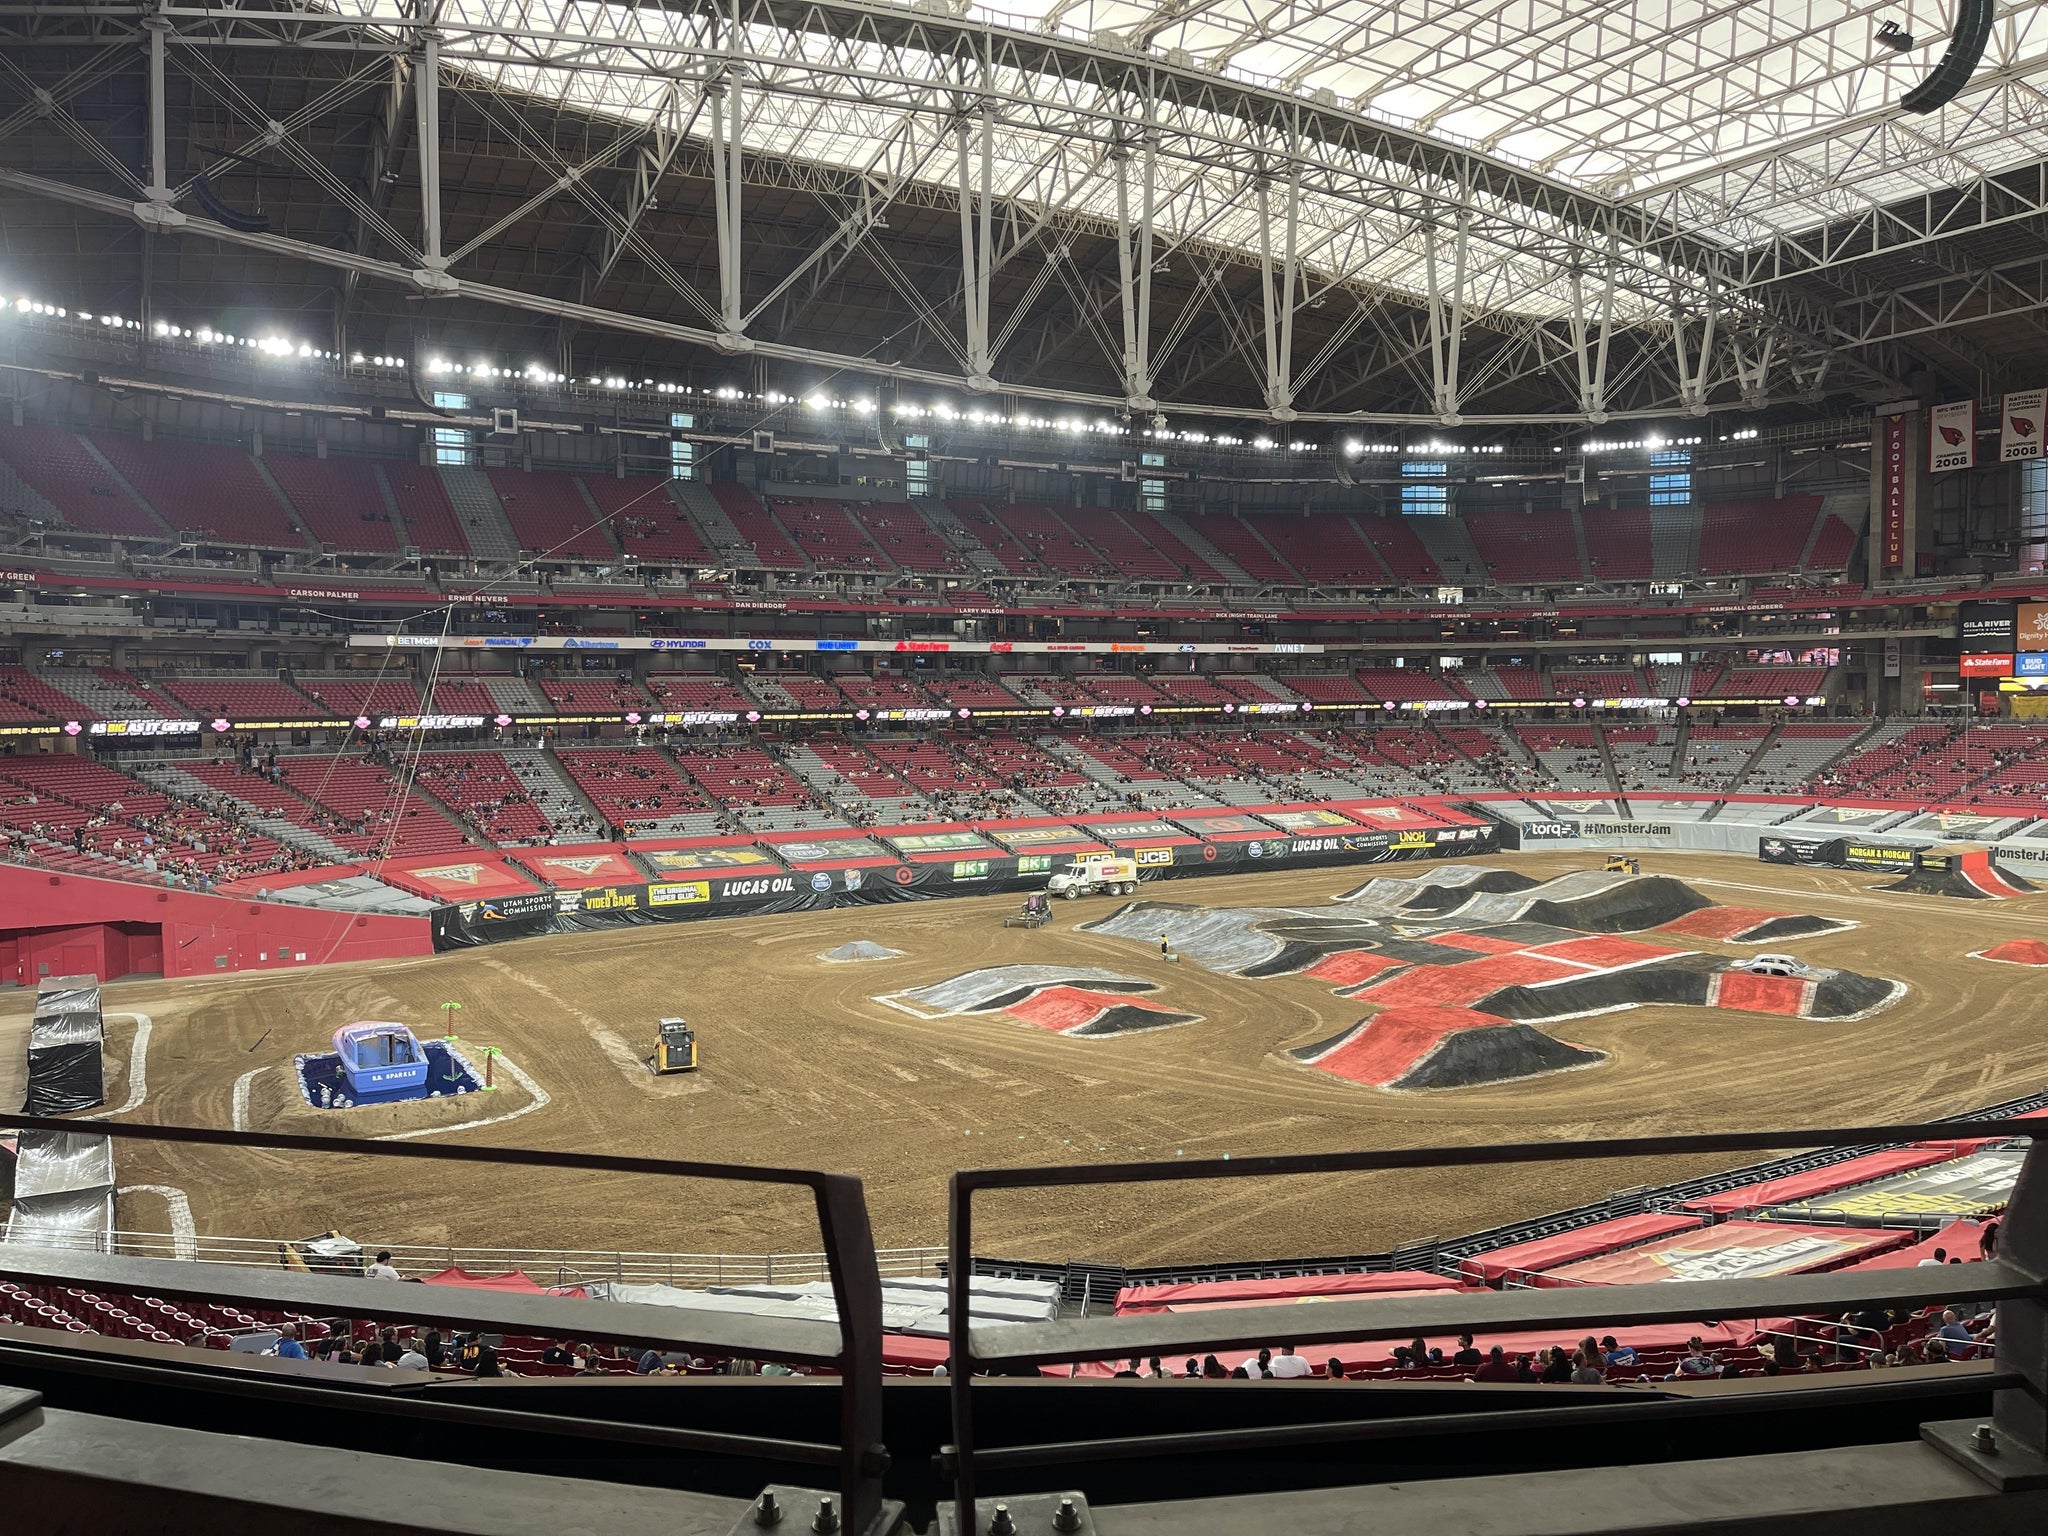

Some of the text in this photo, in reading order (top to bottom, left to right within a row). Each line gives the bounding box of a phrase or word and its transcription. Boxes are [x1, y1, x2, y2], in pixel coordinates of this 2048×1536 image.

[2008, 394, 2042, 402] NATIONAL
[1936, 411, 1967, 419] DIVISION
[2006, 446, 2037, 457] 2008
[1936, 457, 1967, 468] 2008
[7, 572, 35, 581] GREEN
[291, 590, 325, 598] CARSON
[397, 637, 438, 646] BETMGM
[1274, 644, 1304, 653] AVNET
[90, 724, 106, 733] AS
[107, 724, 126, 732] BIG
[127, 722, 145, 732] AS
[380, 719, 397, 727] AS
[1097, 827, 1148, 835] LUCAS
[1584, 823, 1671, 835] #MonsterJam
[902, 834, 973, 844] BKT
[1400, 831, 1425, 842] UNOH
[1292, 839, 1338, 852] LUCAS OIL
[1138, 851, 1171, 863] JCB
[1850, 848, 1875, 857] MORGAN
[1883, 850, 1910, 860] MORGAN
[954, 862, 988, 876] BKT
[1019, 858, 1050, 870] BKT
[604, 888, 617, 897] THE
[723, 880, 768, 896] LUCAS
[503, 895, 551, 908] UTAH SPORTS
[586, 897, 611, 909] VIDEO
[612, 894, 636, 907] GAME
[503, 903, 552, 915] COMMISSION
[386, 1070, 416, 1080] SPARKLE
[464, 1346, 479, 1360] DAD
